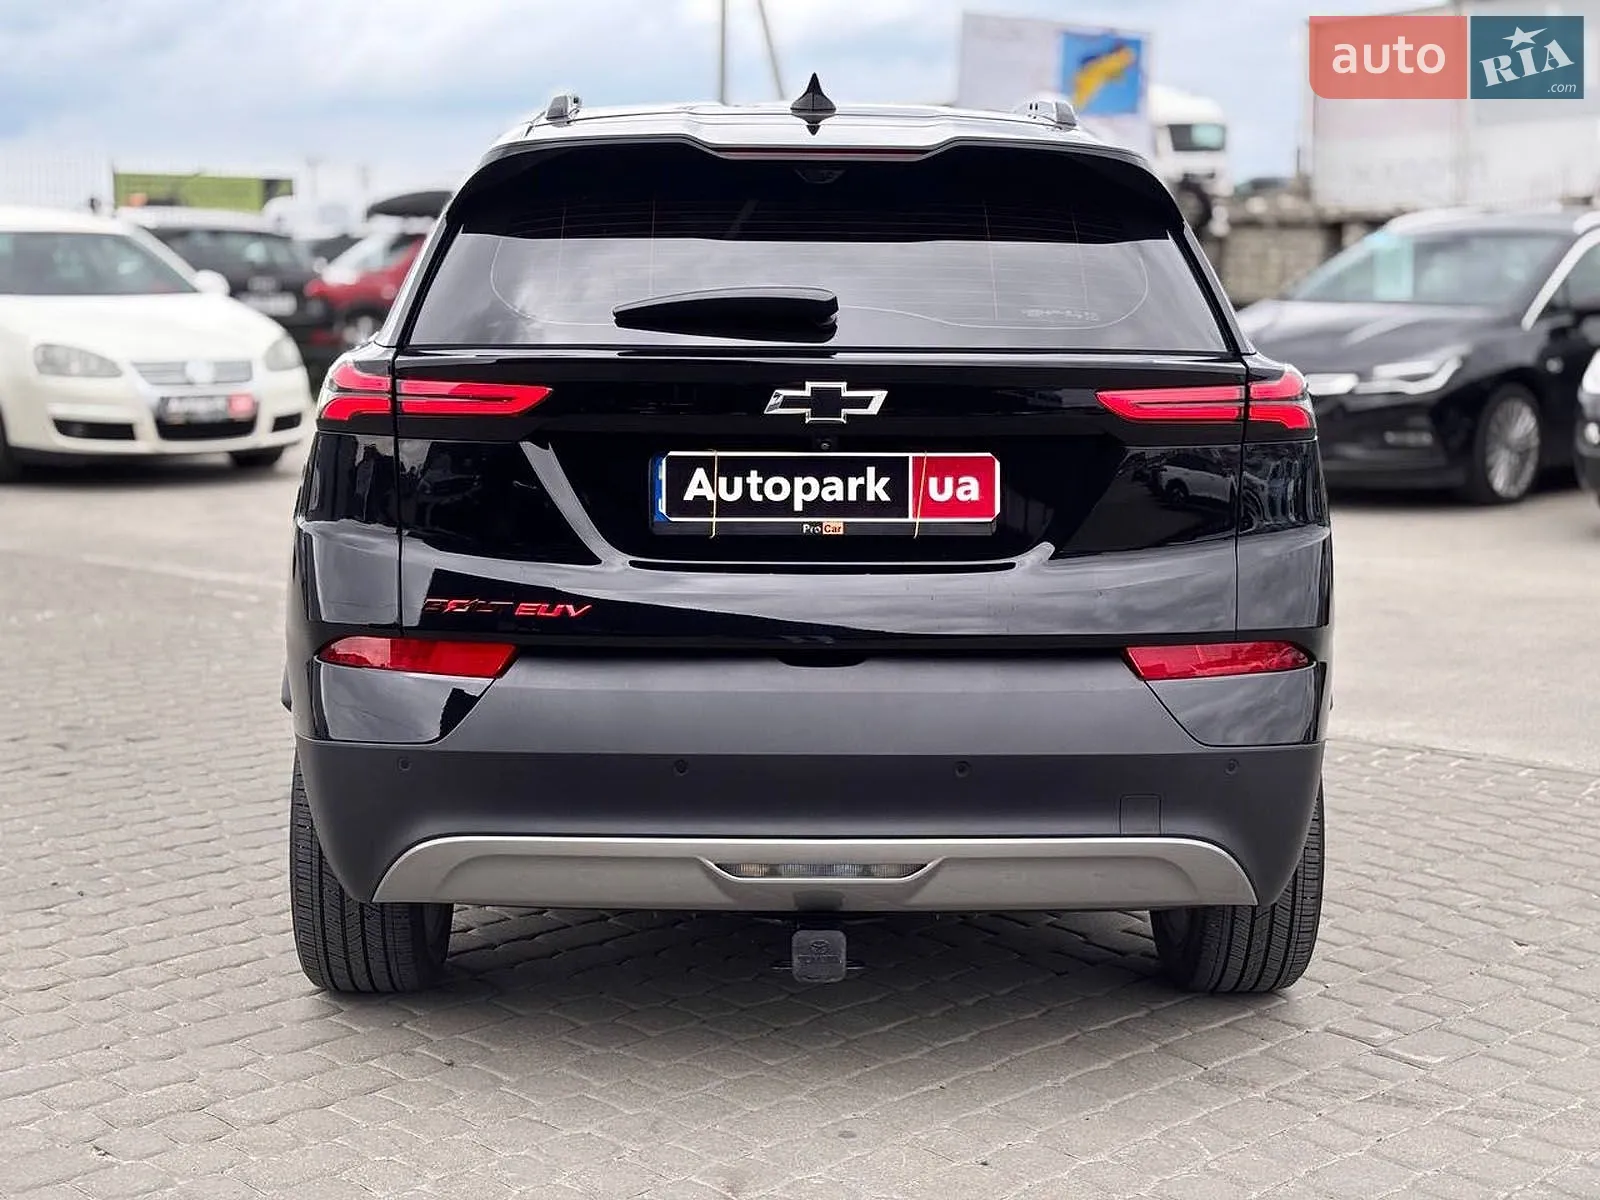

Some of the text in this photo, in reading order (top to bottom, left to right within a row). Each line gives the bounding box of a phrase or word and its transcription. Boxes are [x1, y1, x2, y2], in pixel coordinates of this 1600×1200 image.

[683, 467, 980, 512] Autopark ua
[515, 603, 592, 617] EUV
